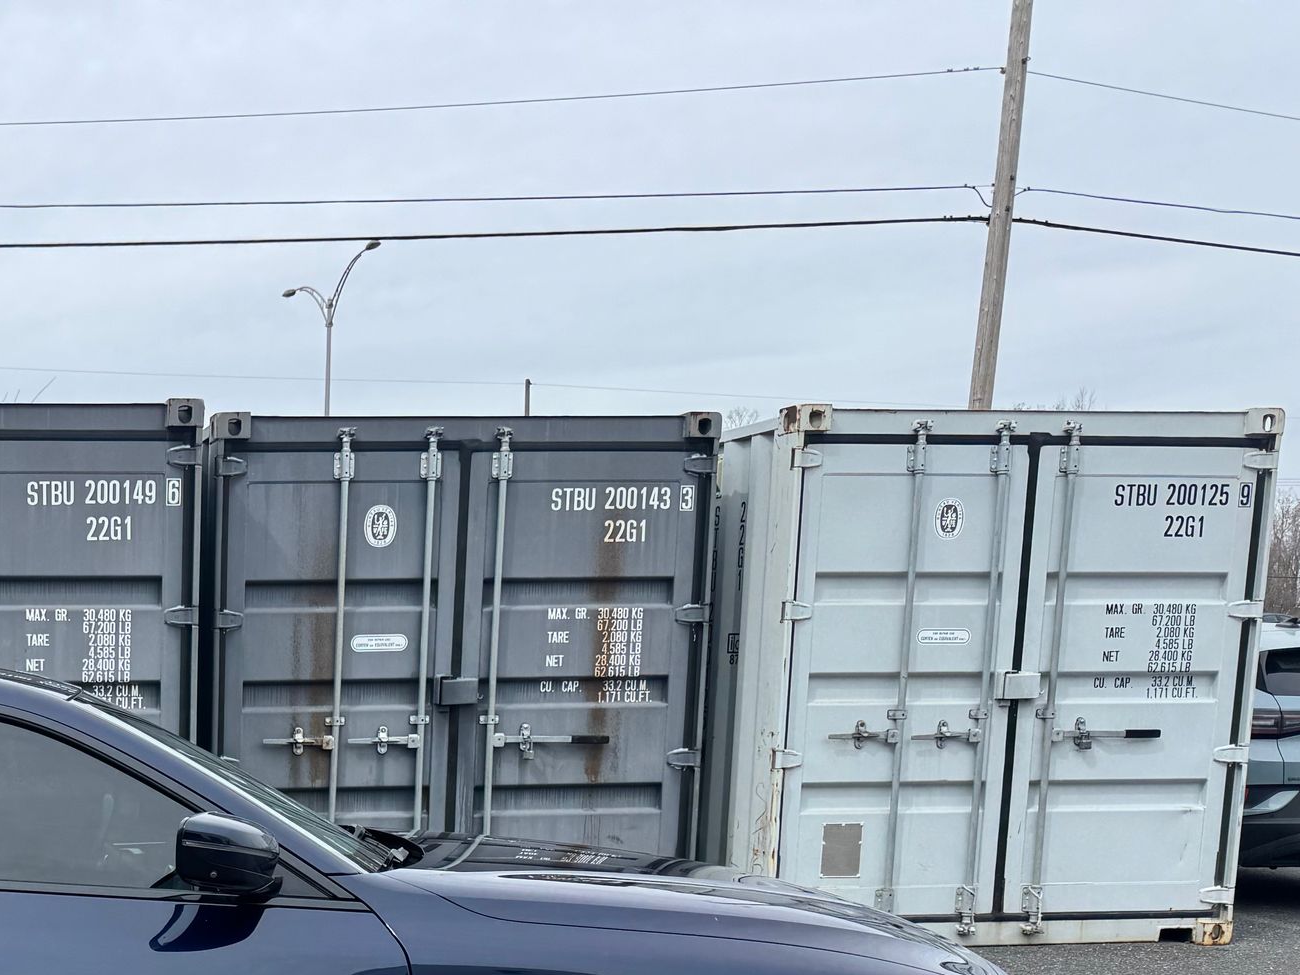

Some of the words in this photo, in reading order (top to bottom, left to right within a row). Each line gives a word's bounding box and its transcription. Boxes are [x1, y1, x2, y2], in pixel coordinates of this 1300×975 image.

[27, 480, 75, 506] STBU
[84, 479, 157, 505] 200149
[167, 479, 180, 505] 6
[551, 487, 597, 511] STBU
[604, 486, 671, 510] 200143
[681, 487, 693, 510] 3
[1114, 483, 1158, 507] STBU
[1166, 483, 1230, 506] 200125
[1239, 483, 1251, 507] 9
[86, 515, 132, 541] 22G1
[603, 519, 647, 543] 22G1
[1164, 515, 1205, 538] 22G1
[25, 609, 50, 622] MAX.
[54, 609, 71, 621] GR.
[119, 608, 132, 621] KG
[547, 607, 570, 620] MAX.
[575, 608, 590, 620] GR.
[631, 607, 644, 619] KG
[1105, 603, 1127, 615] MAX.
[1185, 603, 1197, 615] KG
[119, 621, 131, 633] LB
[630, 619, 643, 631] LB
[1184, 615, 1196, 627] LB
[547, 631, 570, 643] TARE
[630, 631, 642, 643] KG
[1105, 627, 1126, 639] TARE
[1183, 627, 1195, 638] KG
[26, 633, 50, 647] TARE
[118, 634, 131, 646] KG
[1182, 638, 1194, 650] LB
[118, 646, 131, 659] LB
[629, 642, 642, 654] LB
[545, 655, 565, 667] NET
[628, 654, 641, 666] KG
[1102, 650, 1120, 663] NET
[1180, 650, 1193, 661] KG
[25, 658, 46, 672] NET
[118, 658, 131, 671] KG
[628, 666, 640, 677] LB
[1179, 661, 1191, 673] LB
[117, 671, 131, 683] LB
[1093, 677, 1107, 689] CU.
[1113, 677, 1133, 689] CAP.
[540, 681, 555, 693] CU.
[561, 680, 582, 693] CAP.
